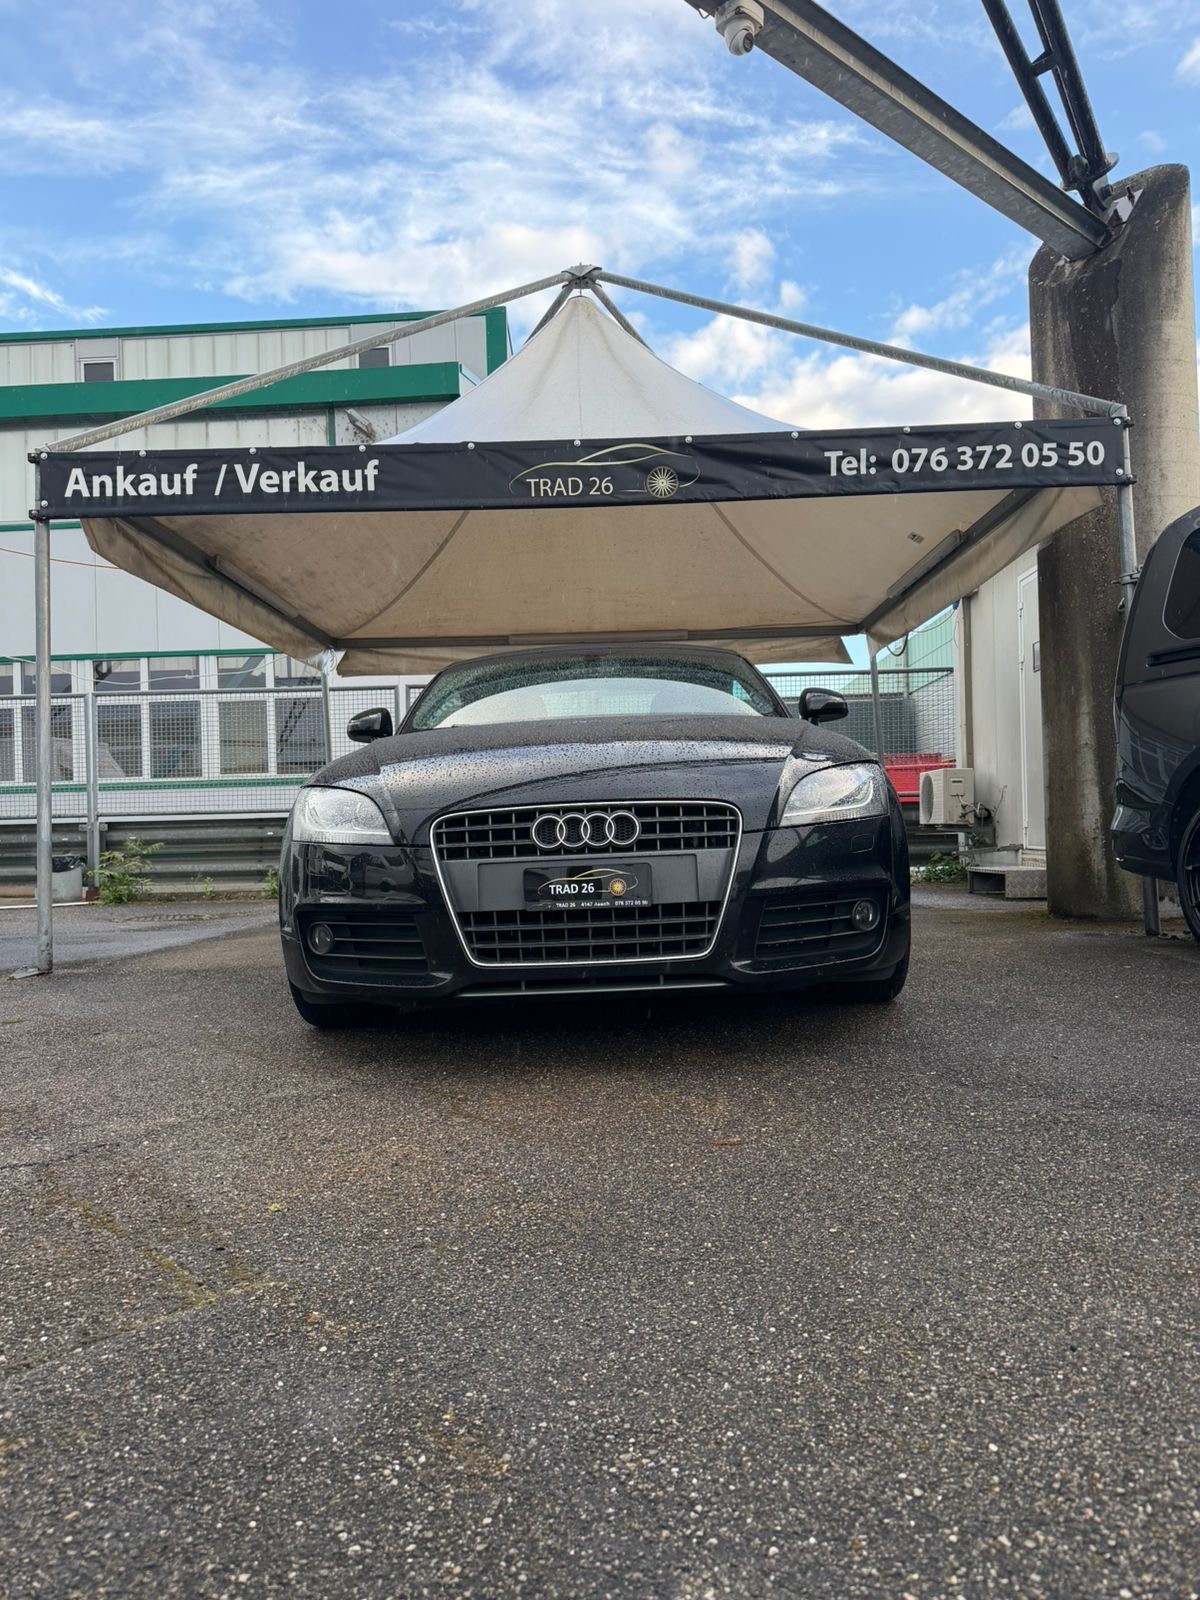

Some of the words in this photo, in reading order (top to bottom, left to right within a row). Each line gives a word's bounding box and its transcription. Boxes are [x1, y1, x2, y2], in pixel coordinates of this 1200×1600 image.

[824, 448, 877, 476] Tel:
[891, 447, 948, 473] 076
[956, 444, 1013, 471] 372
[1021, 442, 1059, 468] 05
[1067, 440, 1105, 466] 50
[64, 463, 198, 498] Ankauf
[526, 477, 583, 497] TRAD
[589, 476, 614, 495] 26
[549, 884, 579, 895] TRAD
[581, 882, 595, 894] 26
